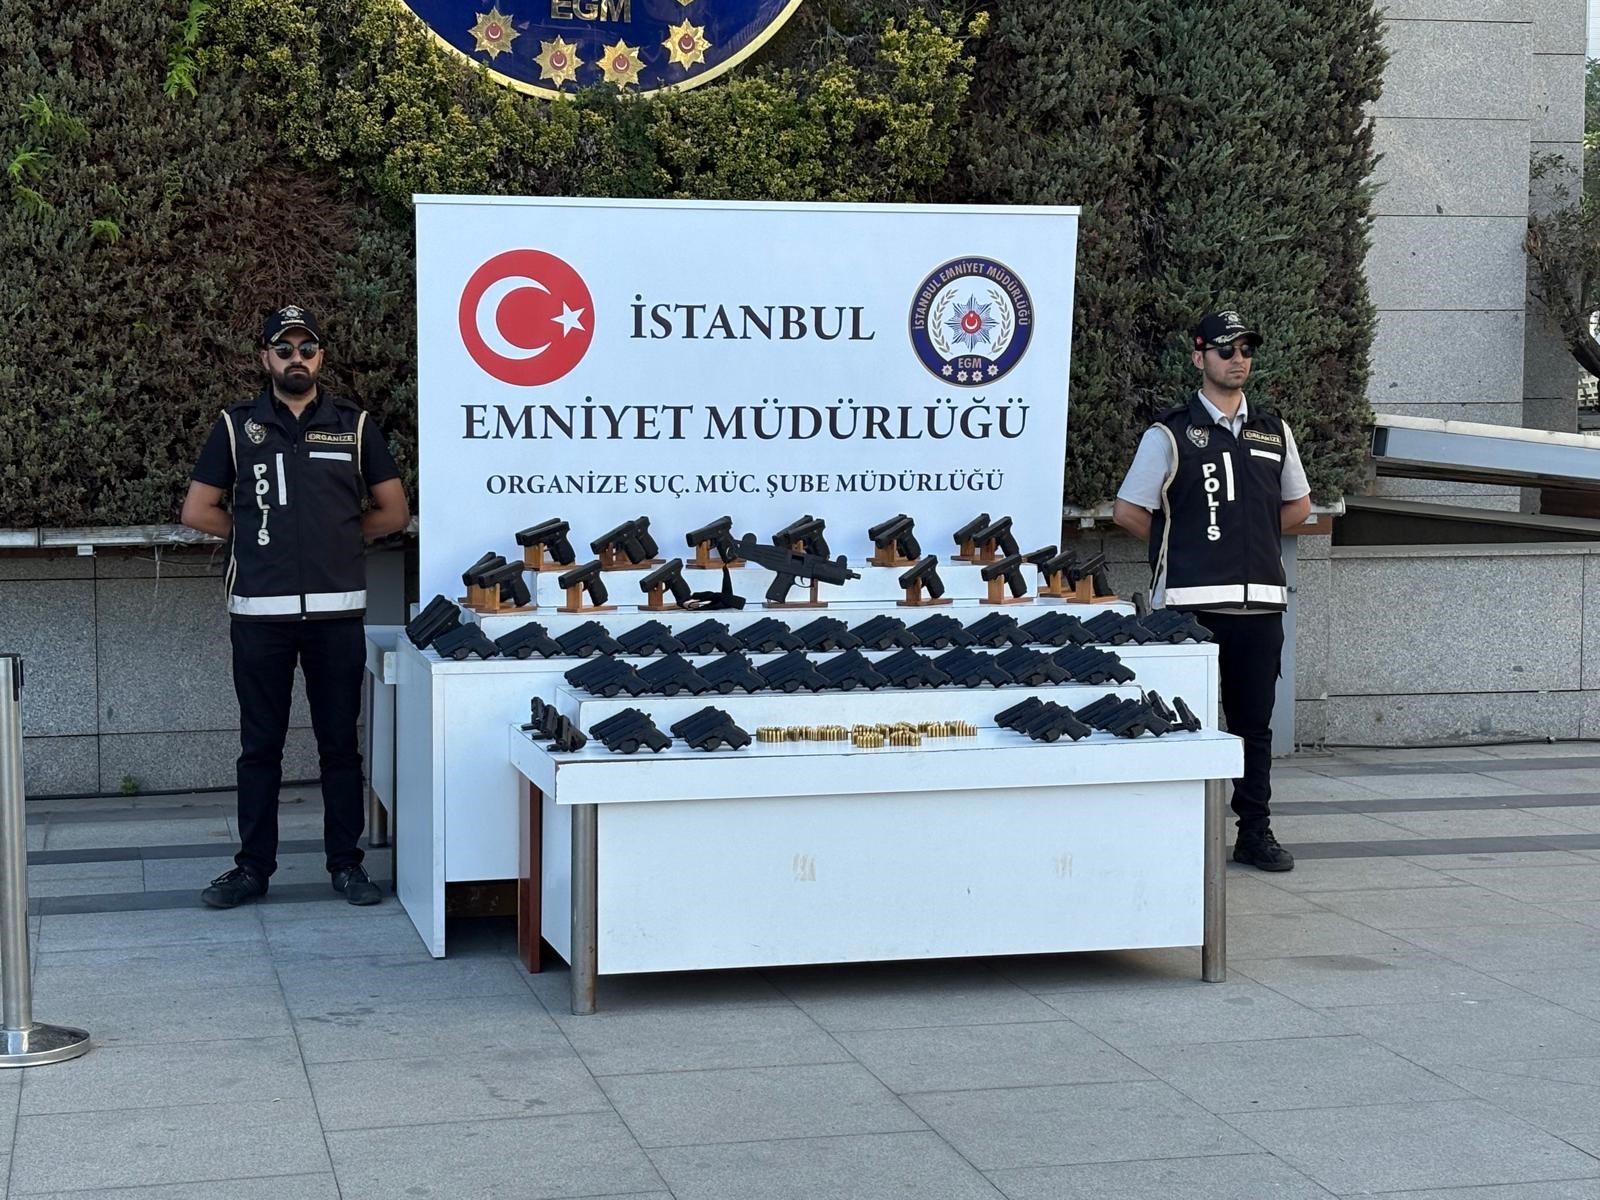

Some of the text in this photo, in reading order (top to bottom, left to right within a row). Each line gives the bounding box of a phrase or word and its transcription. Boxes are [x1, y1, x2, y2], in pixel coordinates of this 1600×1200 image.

[551, 0, 632, 23] EGM
[630, 293, 876, 340] İSTANBUL
[912, 260, 1031, 330] İSTANBUL EMNİYET MÜDÜRLÜĞÜ
[958, 357, 982, 369] EGM
[460, 395, 1030, 440] EMNİYET MÜDÜRLÜĞÜ
[253, 463, 271, 546] POLİS
[486, 468, 1004, 499] ORGANİZE SUÇ. MÜC. ŞUBE MÜDÜRLÜĞÜ
[1202, 462, 1221, 541] POLİS
